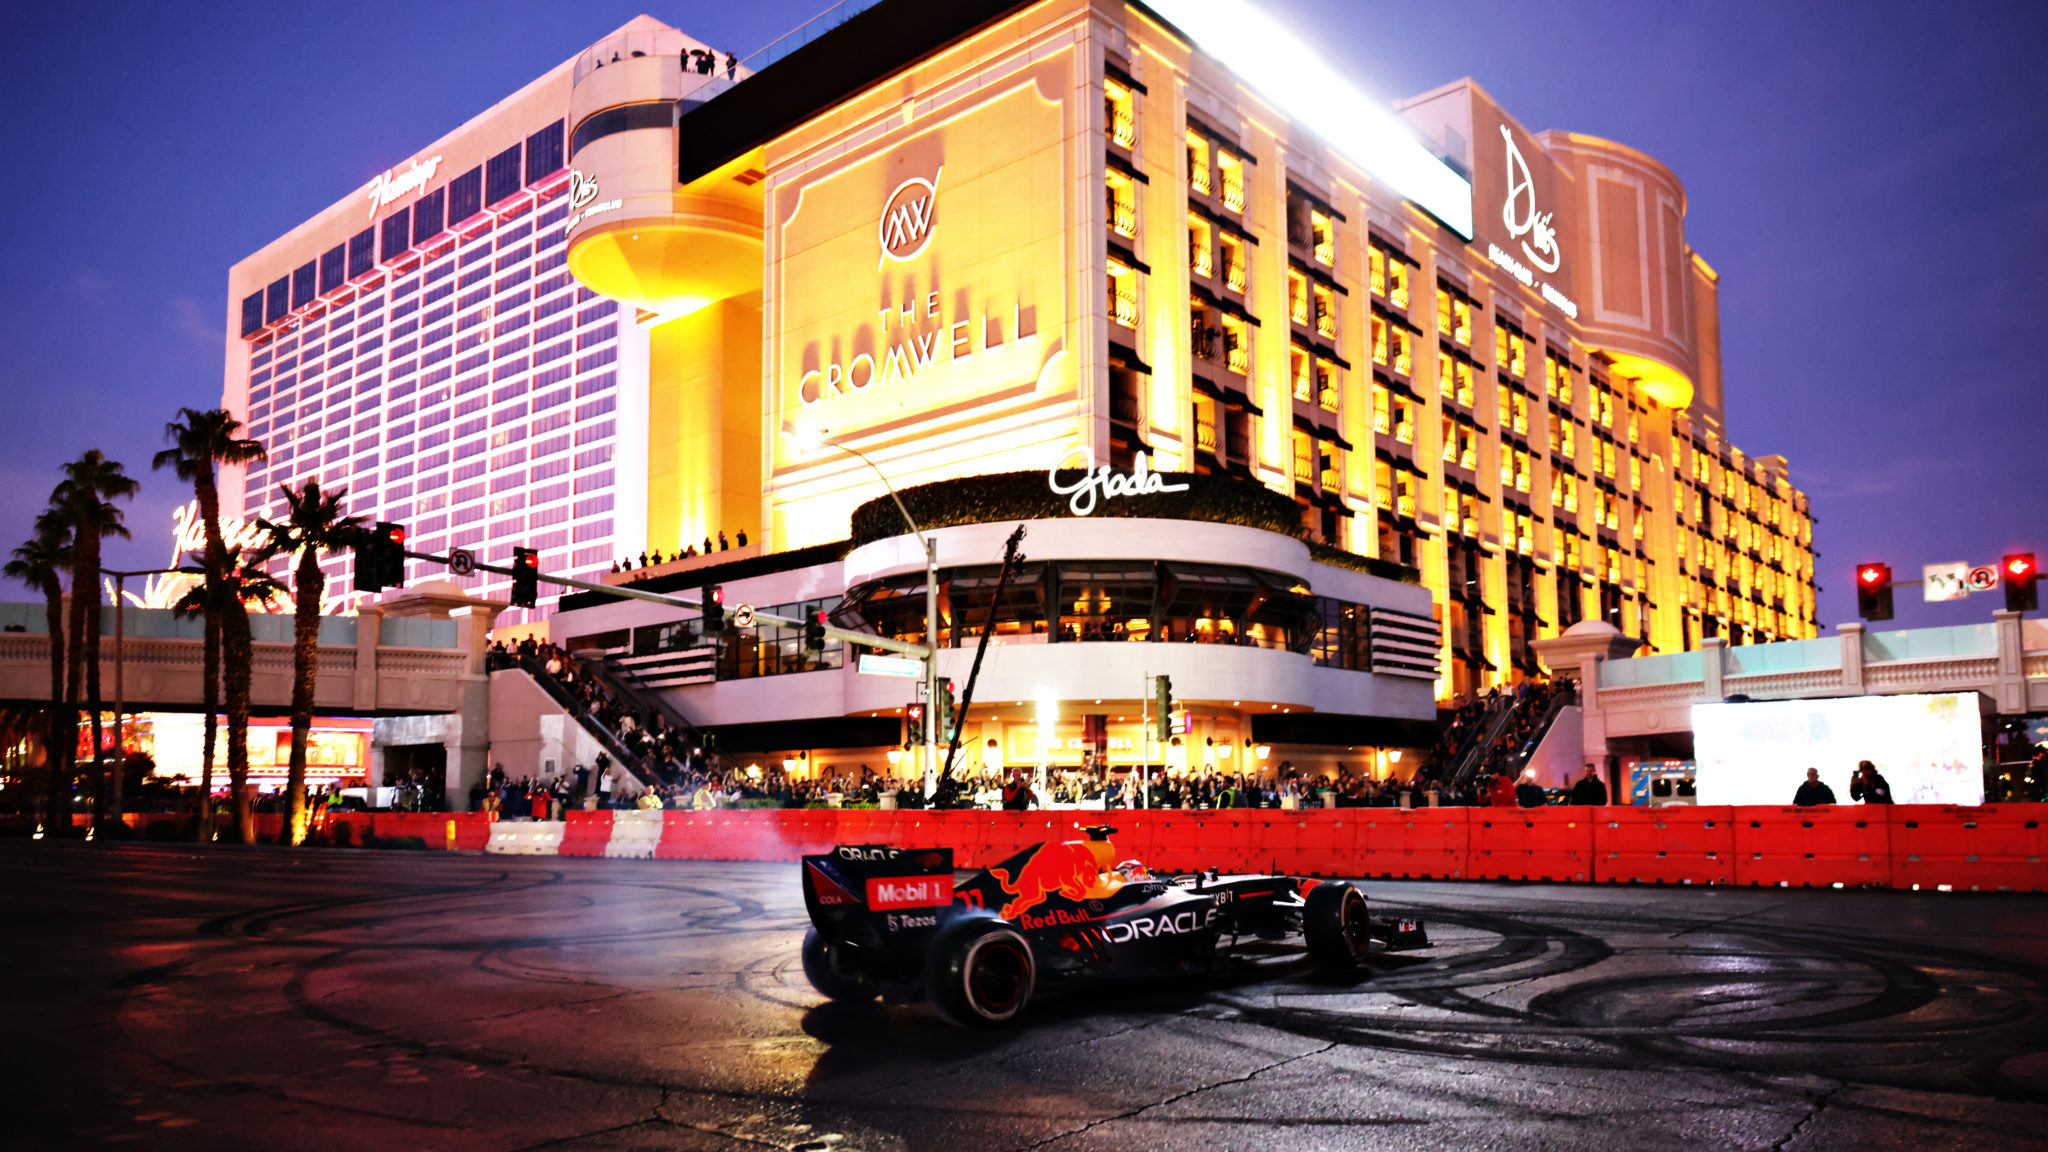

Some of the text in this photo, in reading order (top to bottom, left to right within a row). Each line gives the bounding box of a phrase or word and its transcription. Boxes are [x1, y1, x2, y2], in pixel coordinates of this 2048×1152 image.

[878, 290, 940, 334] THE
[799, 303, 1038, 405] CROMWELL
[1049, 445, 1190, 517] Giada
[878, 882, 927, 903] Mobil
[900, 914, 937, 928] Tezos
[1020, 908, 1091, 931] Red Bull
[1101, 908, 1217, 943] ORACLE
